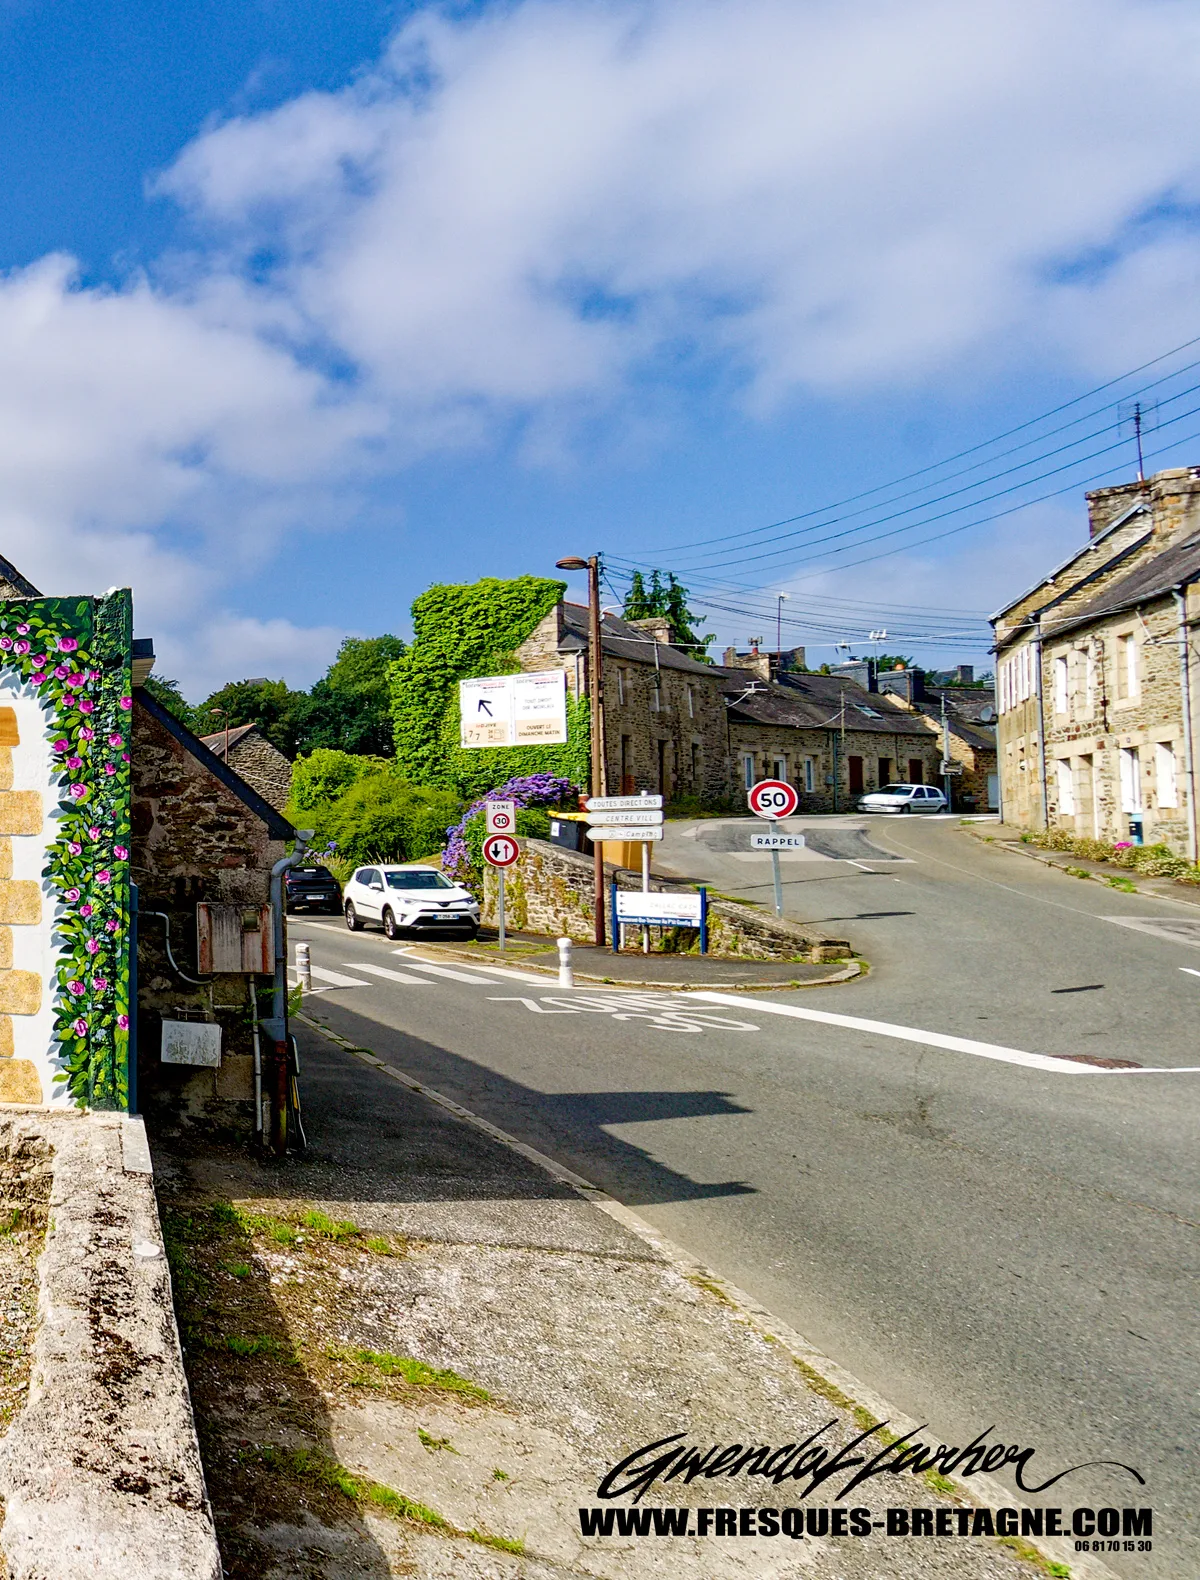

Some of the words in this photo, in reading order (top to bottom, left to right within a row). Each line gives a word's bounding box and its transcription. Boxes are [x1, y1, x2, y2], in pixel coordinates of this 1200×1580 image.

[620, 799, 657, 807] DIRECTONS
[761, 792, 786, 807] 50
[496, 817, 507, 825] 30
[487, 994, 730, 1014] ZONE
[611, 1012, 761, 1032] 30
